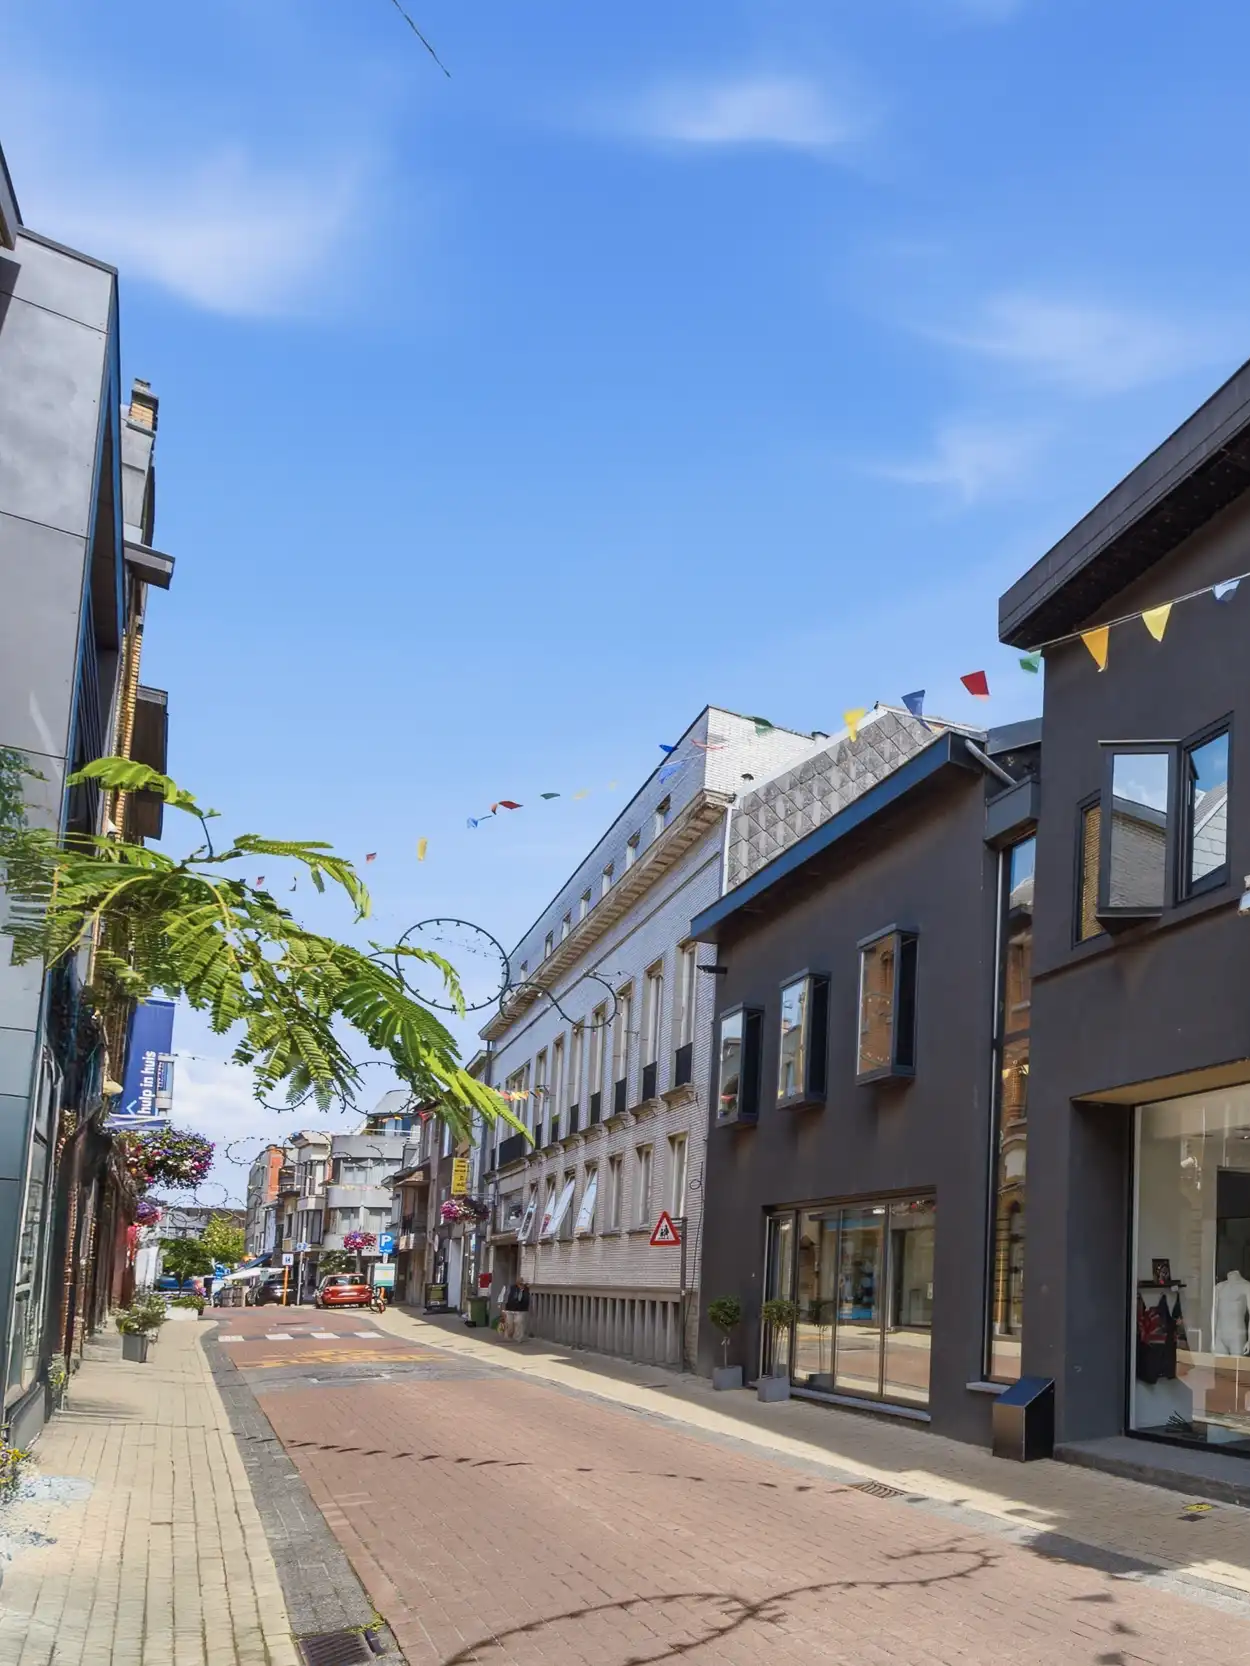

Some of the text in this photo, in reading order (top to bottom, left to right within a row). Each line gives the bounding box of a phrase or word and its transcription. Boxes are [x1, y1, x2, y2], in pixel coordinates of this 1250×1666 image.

[137, 1050, 156, 1114] hulp in huis
[381, 1235, 392, 1247] P
